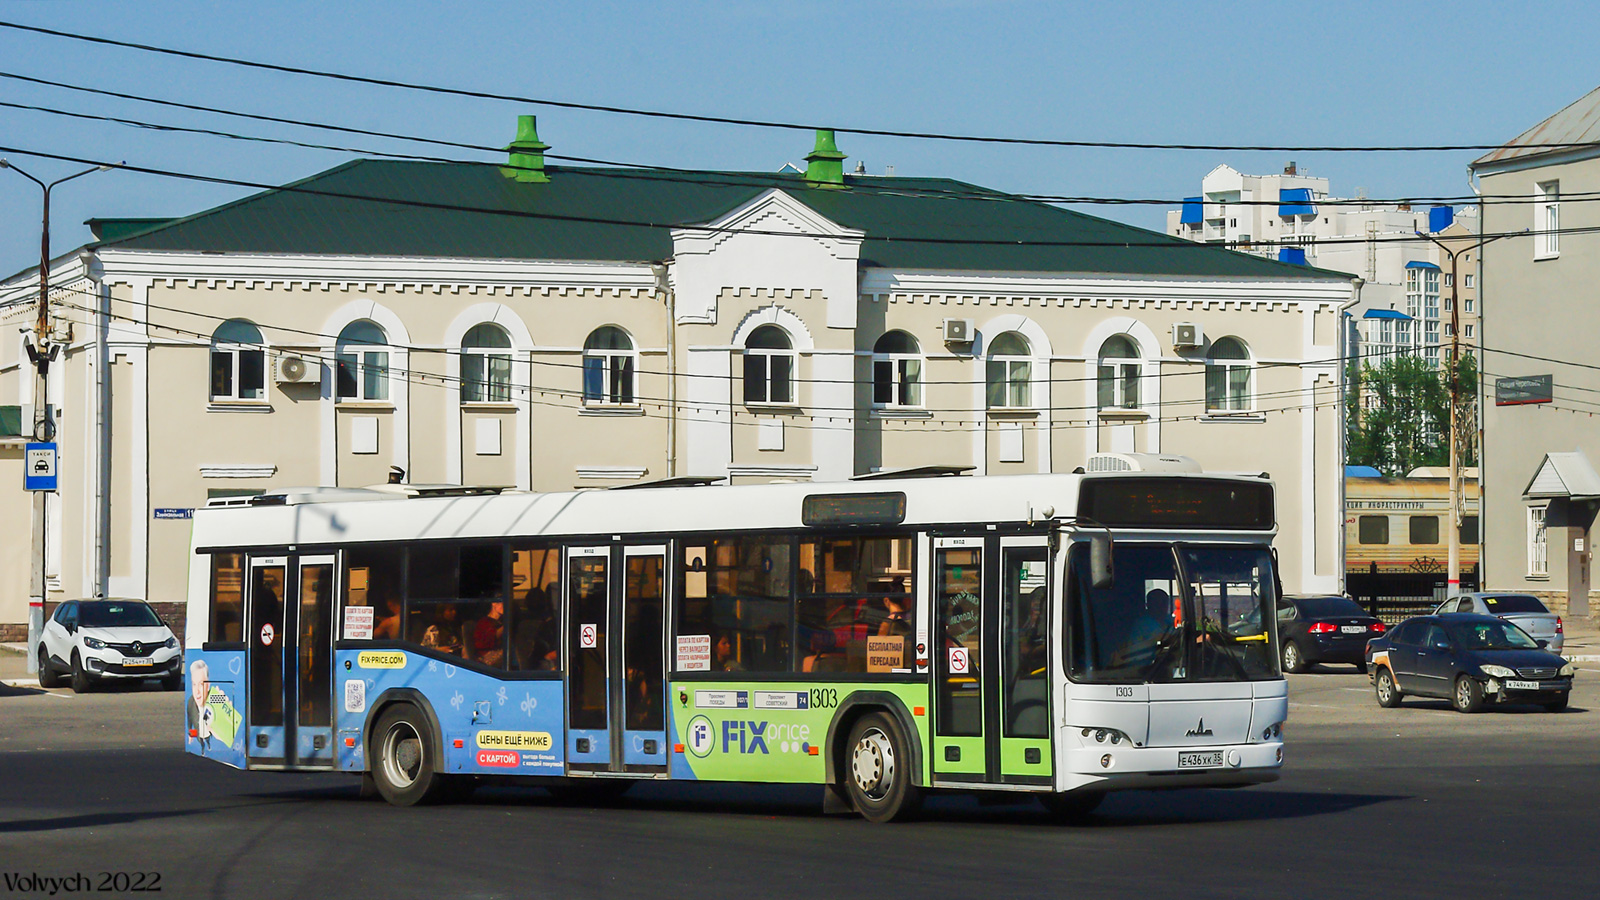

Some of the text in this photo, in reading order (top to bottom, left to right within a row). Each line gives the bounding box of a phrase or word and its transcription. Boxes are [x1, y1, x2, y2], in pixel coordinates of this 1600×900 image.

[1368, 501, 1425, 509] ИНФРАСТРУКТУРЫ
[868, 642, 903, 652] БЕСПЛАТНАЯ
[869, 656, 900, 667] ПЕРЕСАДКА
[1115, 686, 1134, 698] 1303
[799, 697, 808, 705] 74
[809, 688, 839, 709] 1303
[767, 723, 811, 745] price
[480, 734, 548, 746] ЦЕНЫ ЕЩЁ НИЖЕ
[480, 754, 516, 764] С КАРТОЙ!
